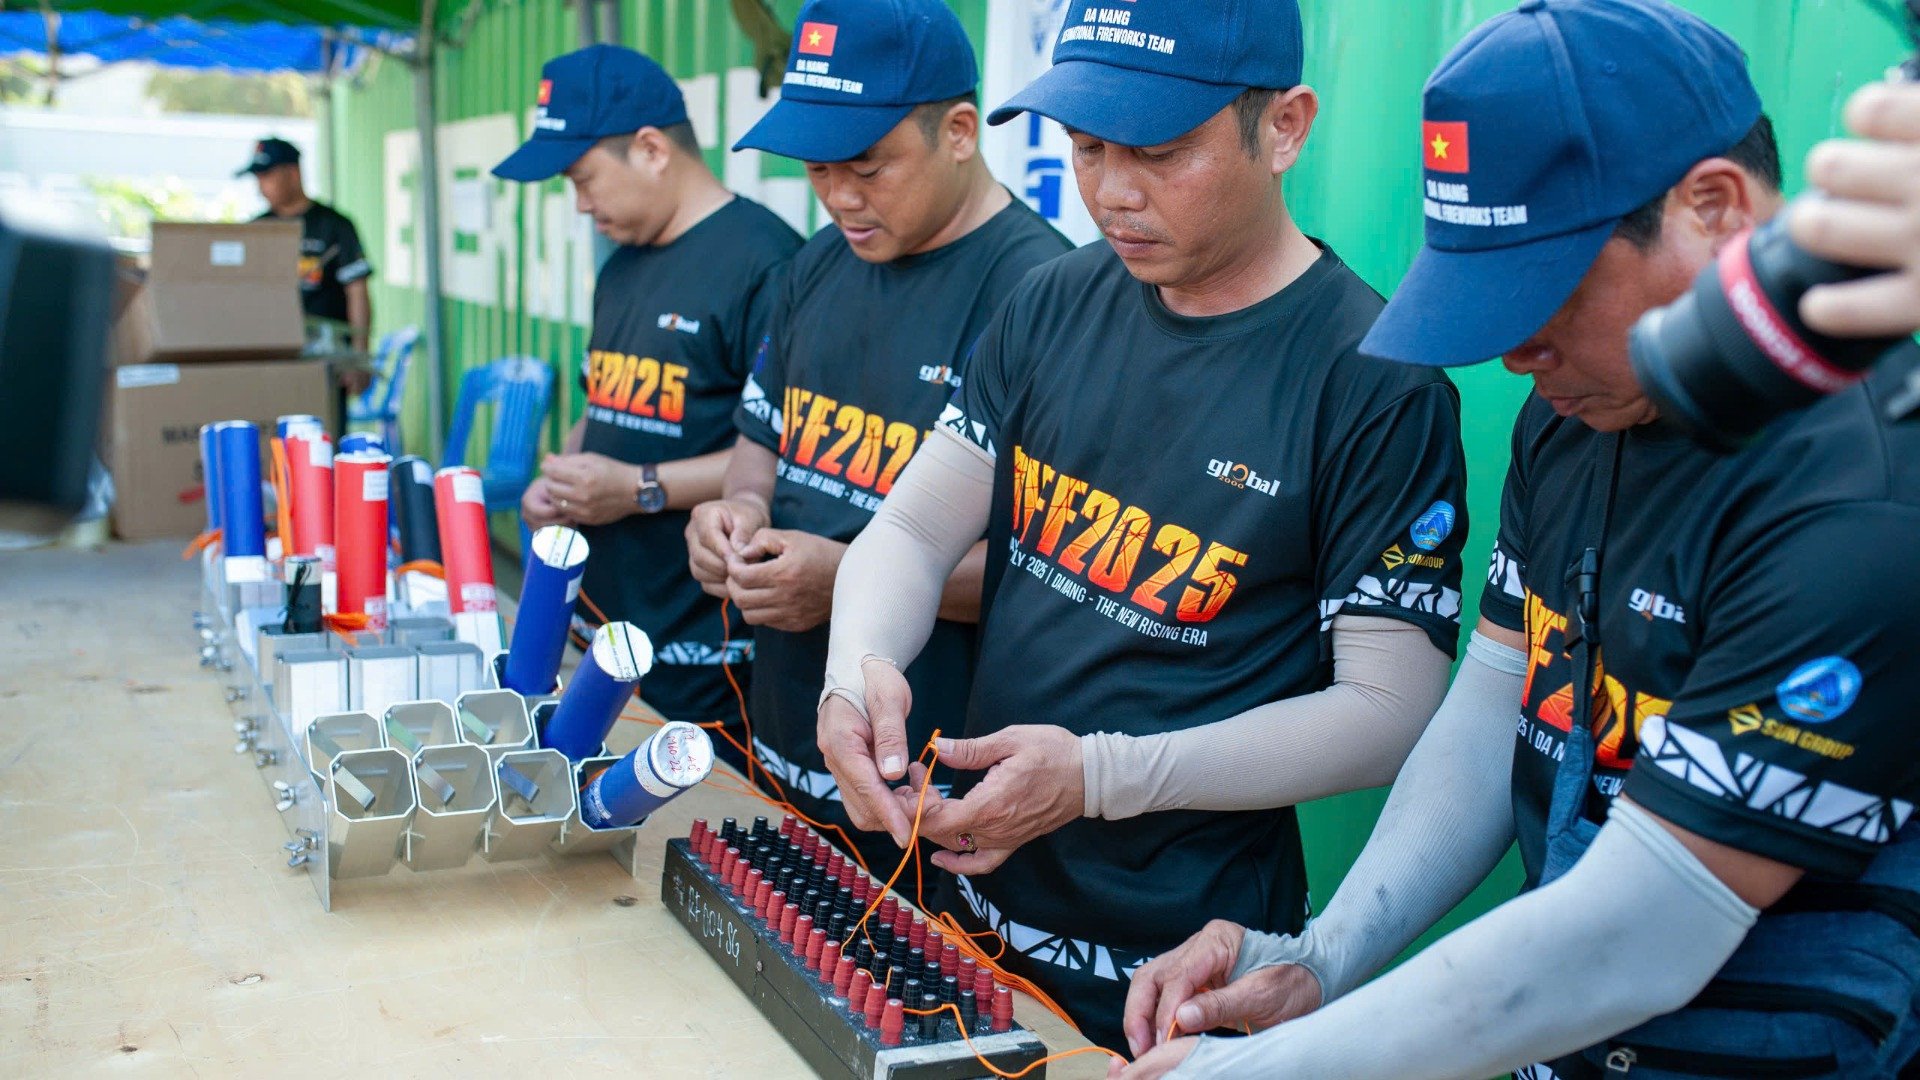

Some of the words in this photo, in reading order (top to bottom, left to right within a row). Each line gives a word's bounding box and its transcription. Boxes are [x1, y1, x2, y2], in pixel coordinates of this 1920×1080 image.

[1083, 8, 1097, 23] DA
[1098, 8, 1131, 26] NANG
[1096, 26, 1147, 48] FIREWORKS
[1147, 34, 1176, 55] TEAM
[842, 79, 863, 95] TEAM
[1491, 204, 1528, 227] TEAM
[1206, 458, 1281, 497] global
[1218, 475, 1245, 490] 2000
[1095, 595, 1120, 618] THE
[1115, 606, 1142, 629] NEW
[1137, 616, 1182, 641] RISING
[1181, 627, 1209, 647] ERA
[1535, 731, 1553, 755] DA
[1760, 718, 1801, 745] SUN
[1797, 730, 1856, 760] GROUP
